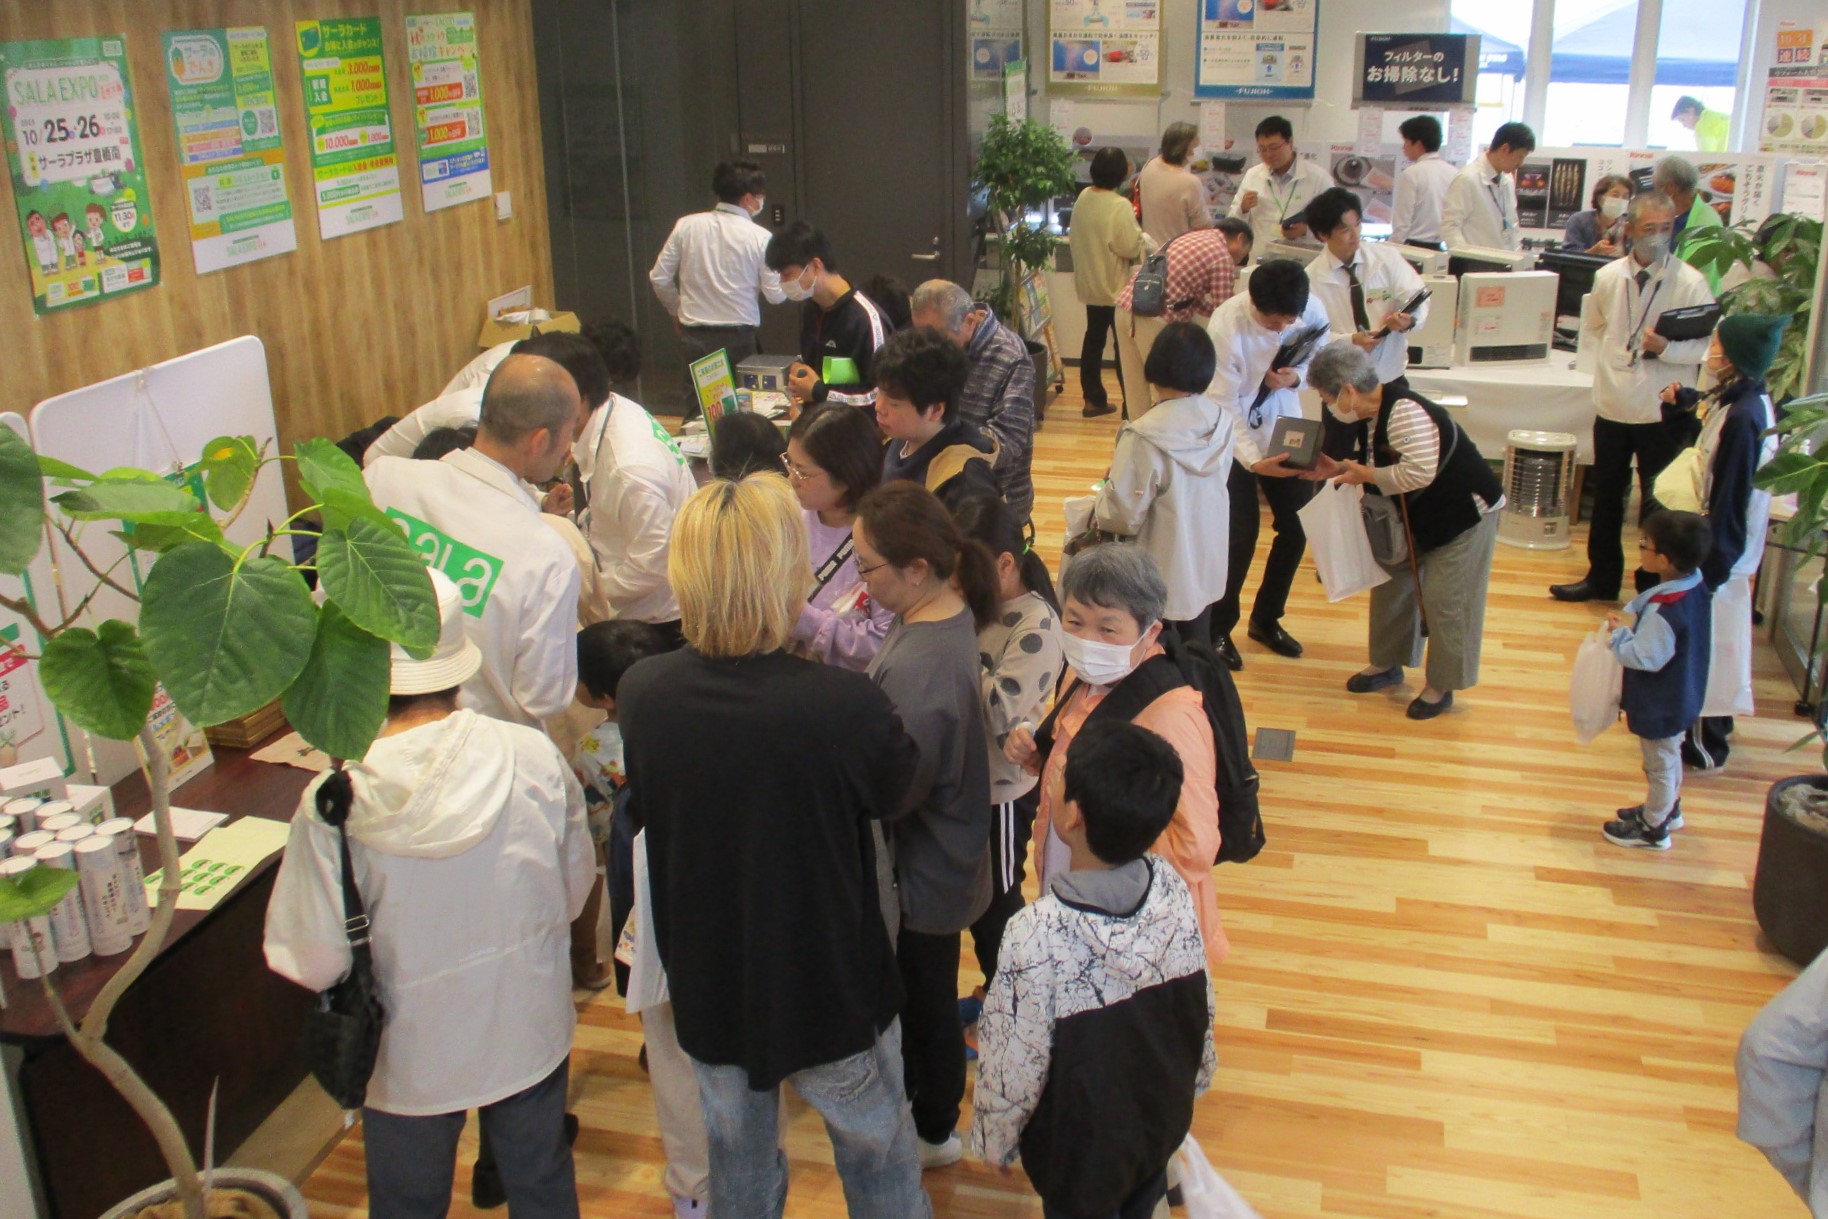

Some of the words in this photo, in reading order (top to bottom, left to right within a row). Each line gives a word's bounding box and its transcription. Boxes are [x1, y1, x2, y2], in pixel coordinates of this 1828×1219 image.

[1384, 51, 1445, 62] フィルターの
[1367, 65, 1459, 82] お掃除なし!
[14, 78, 57, 106] SALA
[58, 75, 98, 102] EXPO
